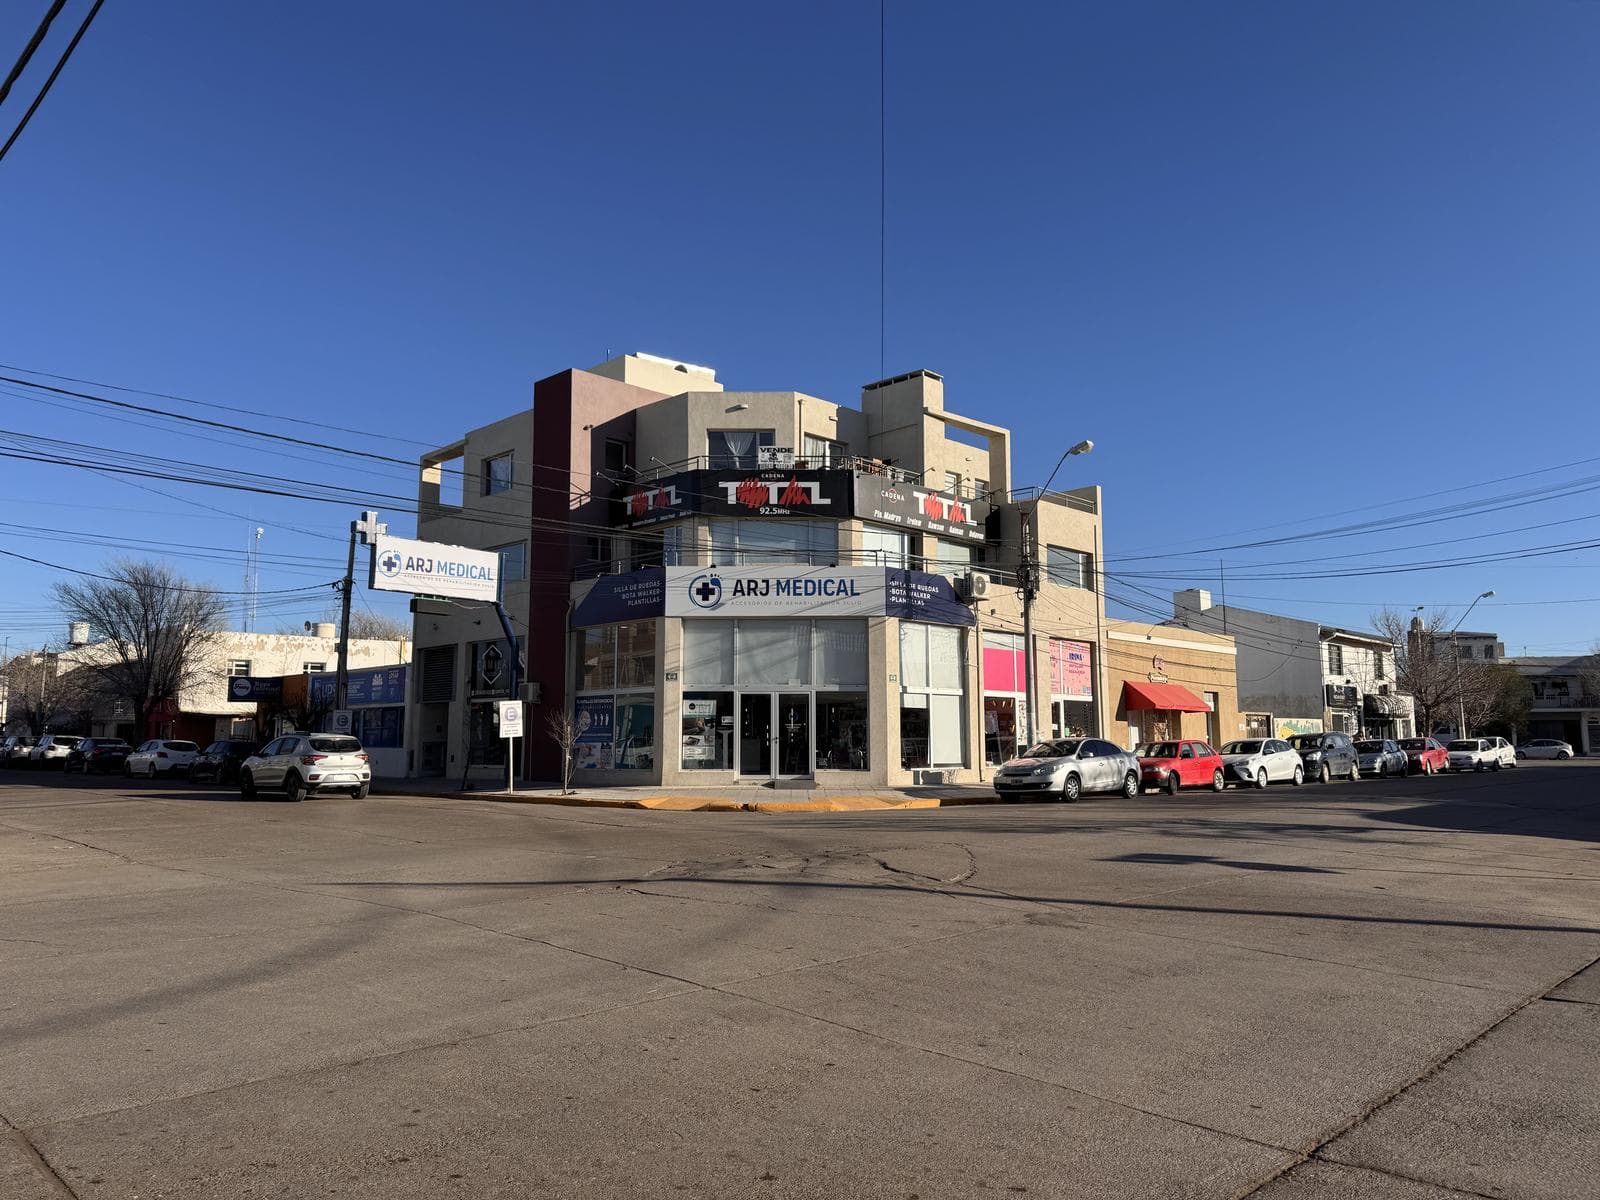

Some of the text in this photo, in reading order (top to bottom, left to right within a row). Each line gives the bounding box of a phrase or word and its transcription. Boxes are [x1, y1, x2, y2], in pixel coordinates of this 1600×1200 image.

[881, 490, 905, 501] CADENA
[405, 556, 494, 581] ARJ MEDICAL
[732, 579, 861, 597] ARJ MEDICAL
